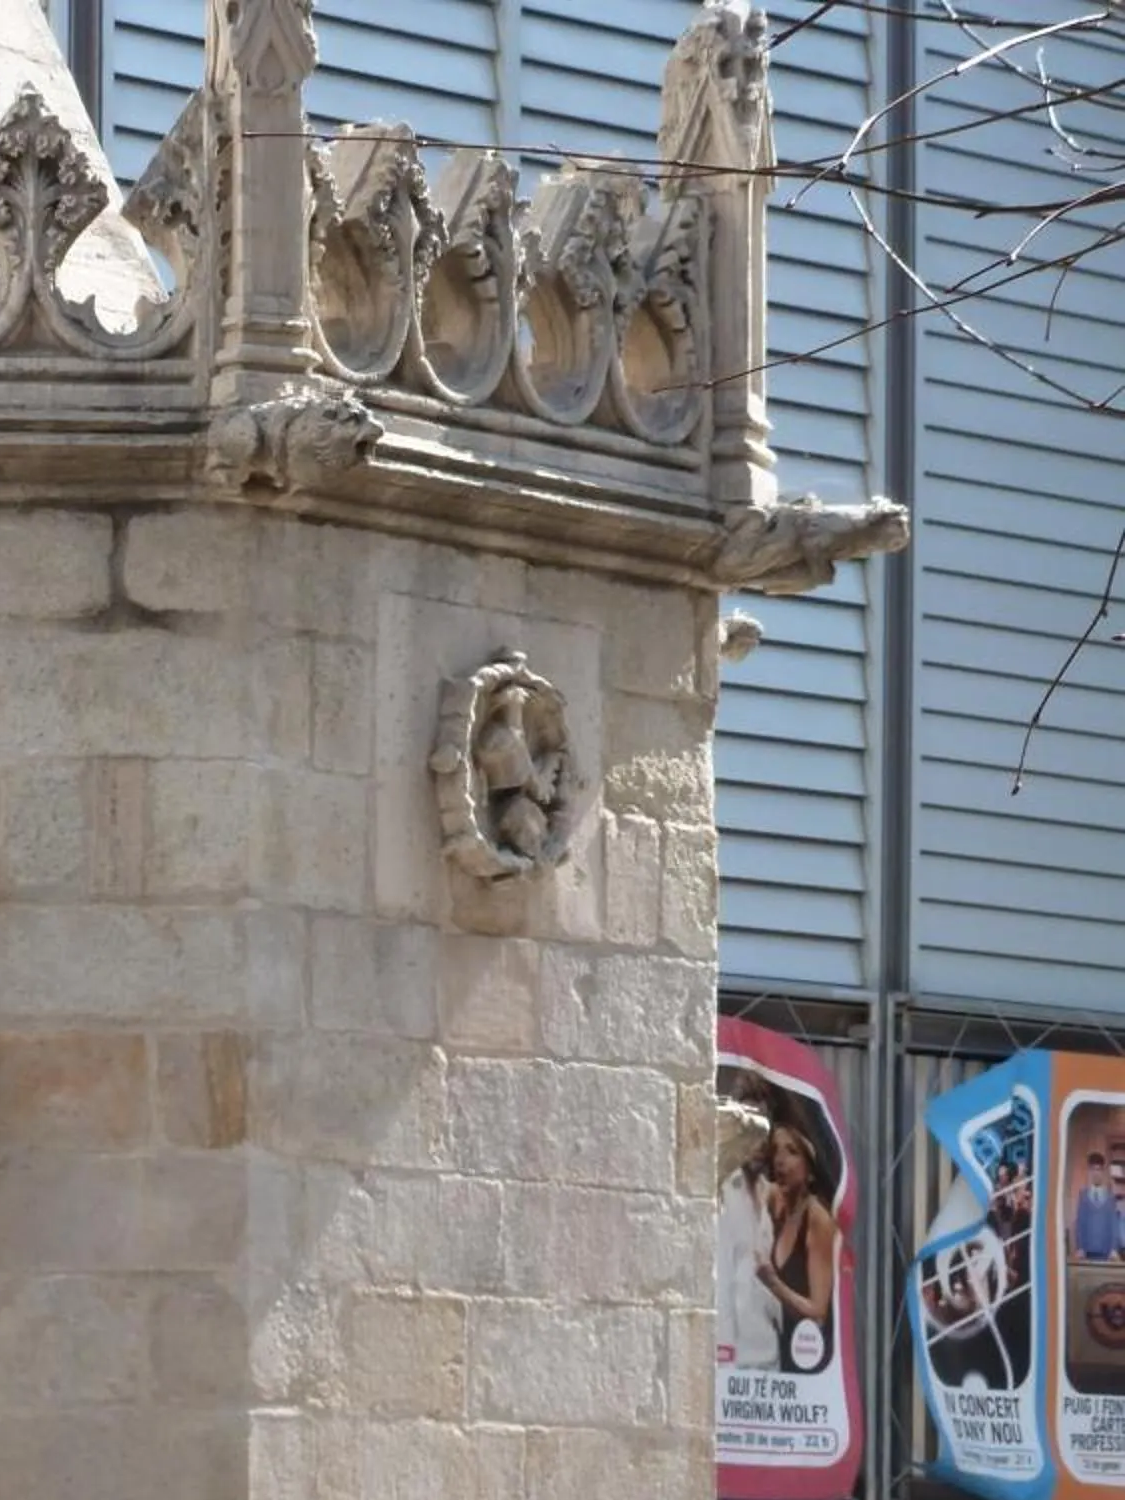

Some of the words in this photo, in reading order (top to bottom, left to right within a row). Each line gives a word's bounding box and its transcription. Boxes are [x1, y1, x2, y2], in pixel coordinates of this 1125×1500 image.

[728, 1376, 750, 1396] QUI
[771, 1380, 797, 1400] POR
[779, 1402, 828, 1424] WOLF?
[958, 1393, 1020, 1420] CONCERT
[1064, 1396, 1091, 1415] PUIG
[990, 1421, 1023, 1444] NOU
